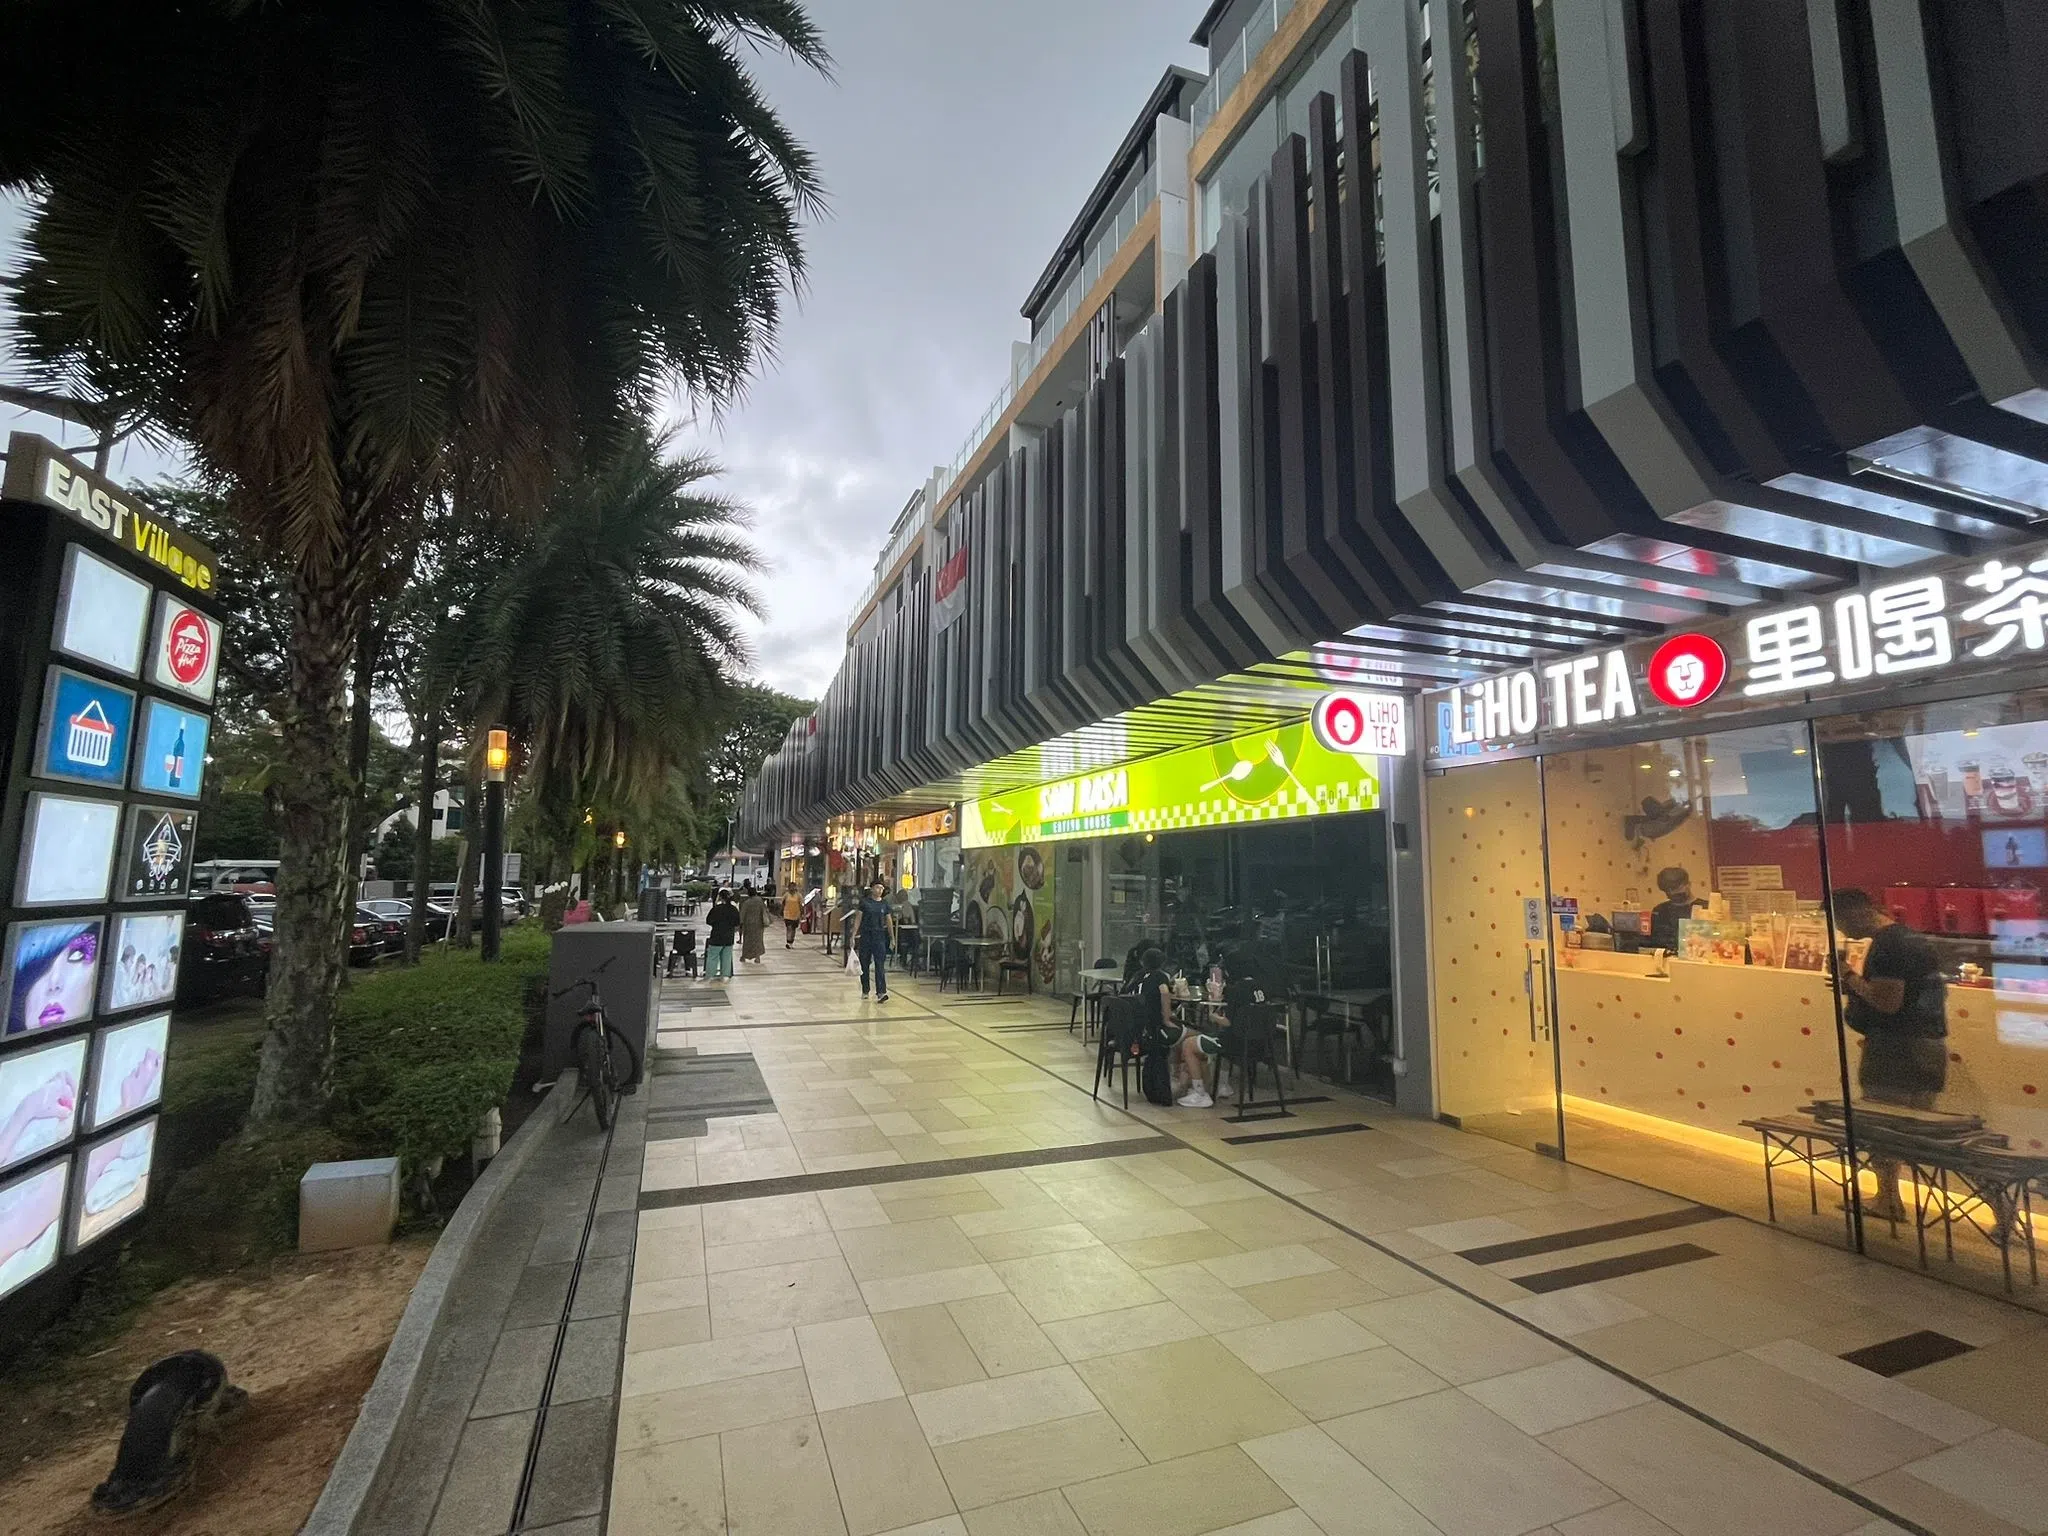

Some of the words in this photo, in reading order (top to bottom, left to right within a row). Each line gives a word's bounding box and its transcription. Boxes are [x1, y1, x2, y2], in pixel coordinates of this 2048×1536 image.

[45, 458, 129, 539] EAST
[133, 512, 212, 590] Village
[174, 637, 201, 655] Pizza
[178, 654, 199, 668] Hut
[1451, 671, 1537, 743] LiHO
[1547, 650, 1637, 728] TEA
[1369, 701, 1399, 725] LiHO
[1373, 725, 1397, 749] TEA
[1079, 769, 1129, 813] RASA
[1319, 785, 1368, 806] #01-11
[1084, 814, 1112, 831] HOUSE
[1253, 989, 1265, 1003] 18
